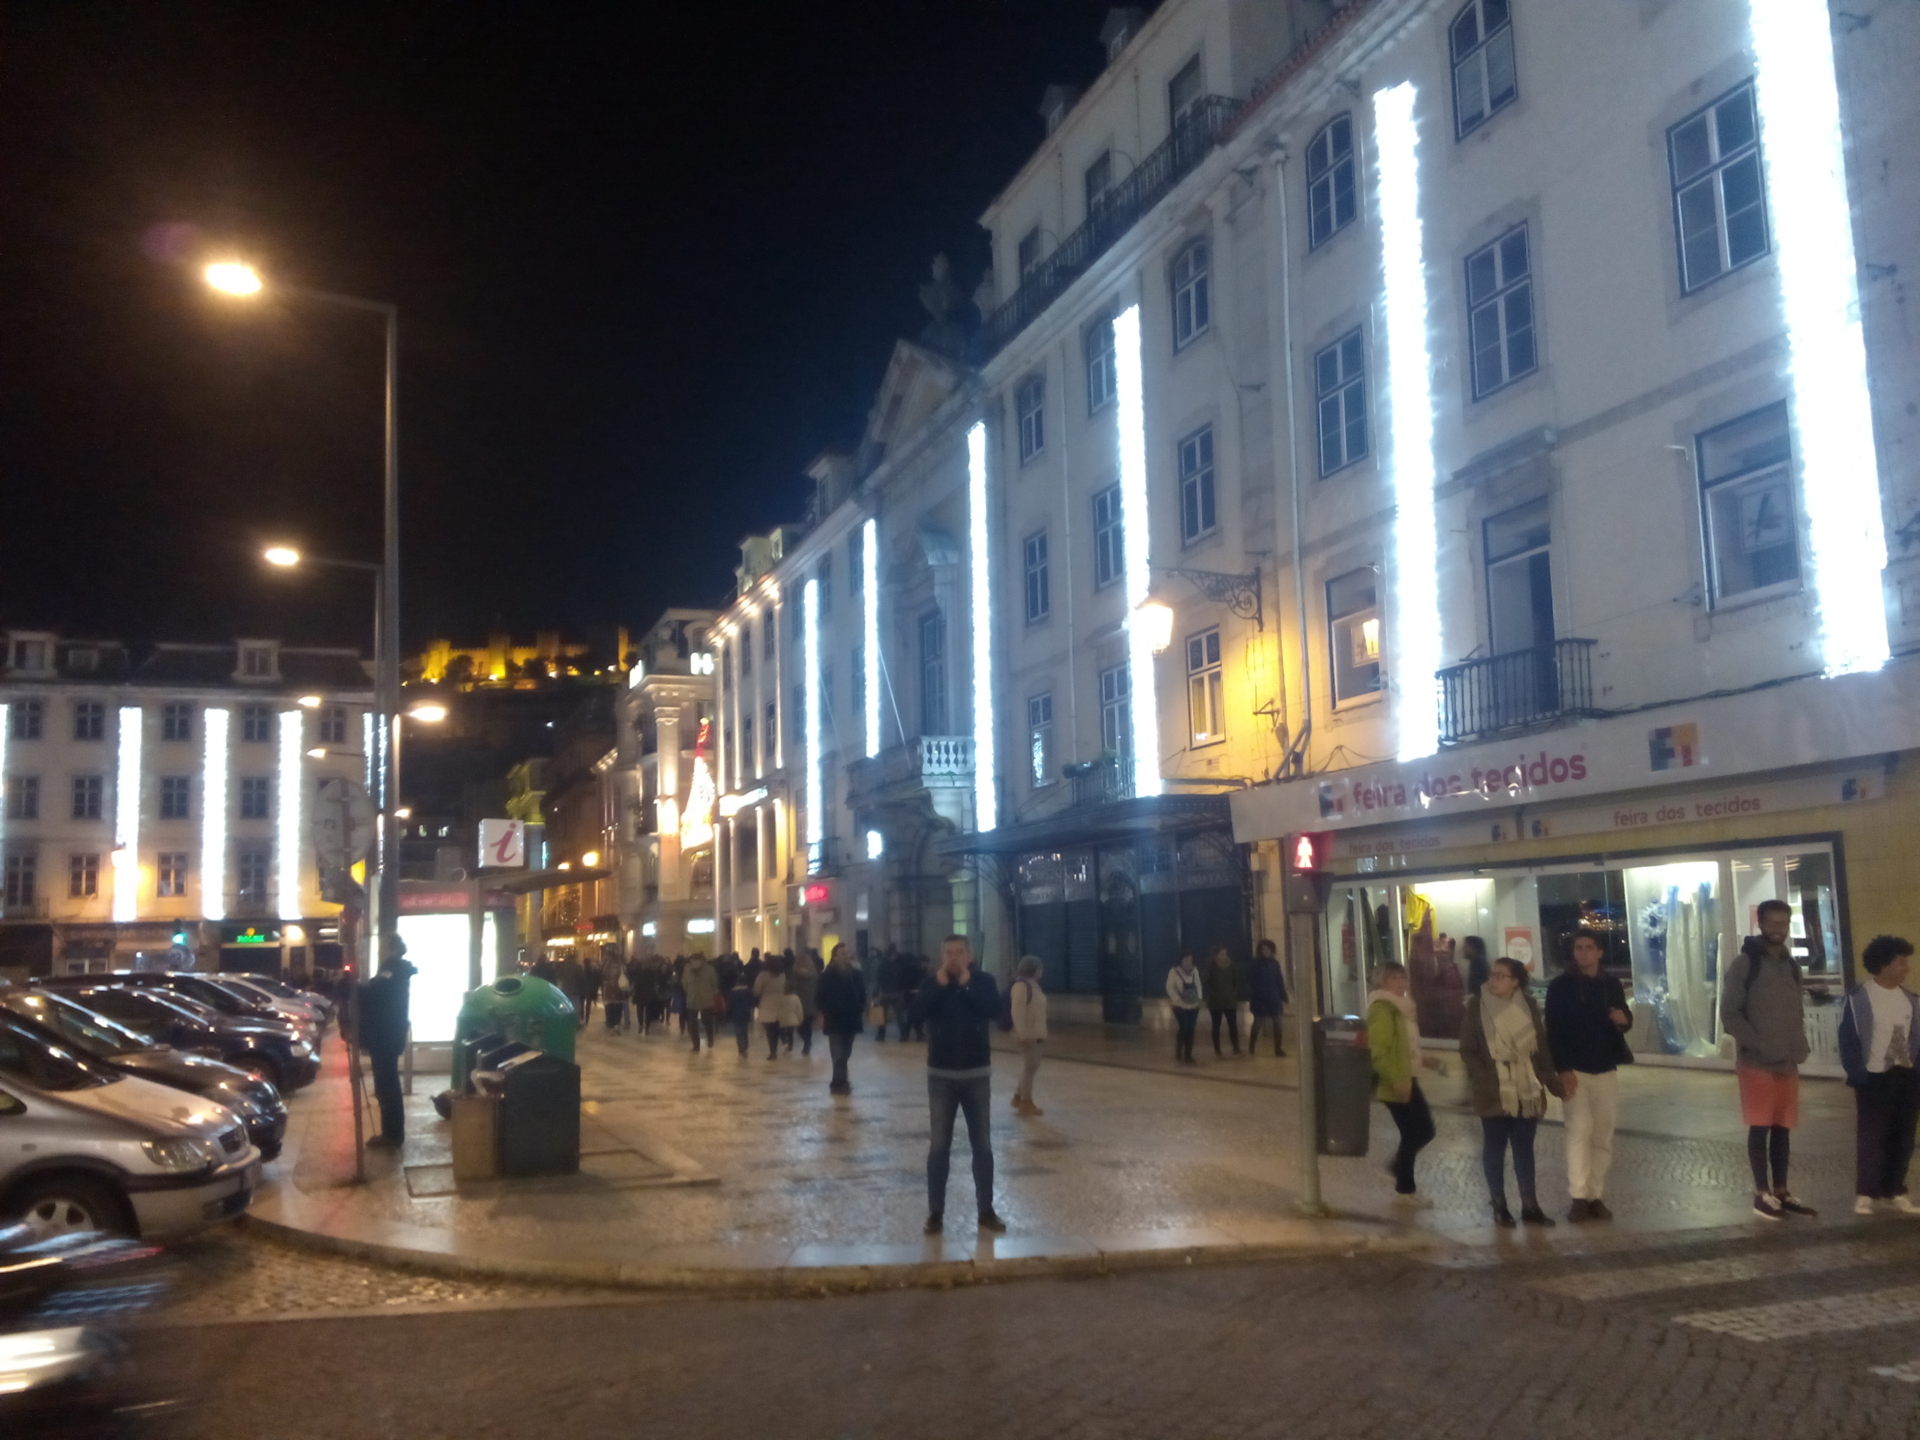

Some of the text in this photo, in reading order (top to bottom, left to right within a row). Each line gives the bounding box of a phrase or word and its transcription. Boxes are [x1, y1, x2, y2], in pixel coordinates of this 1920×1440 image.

[1353, 780, 1406, 811] feira
[1414, 771, 1462, 798] dos
[1471, 751, 1587, 794] tecidos
[1613, 796, 1761, 827] feira dos tecidos
[490, 822, 517, 864] i
[1375, 838, 1395, 852] dos
[1400, 834, 1440, 850] tecidos
